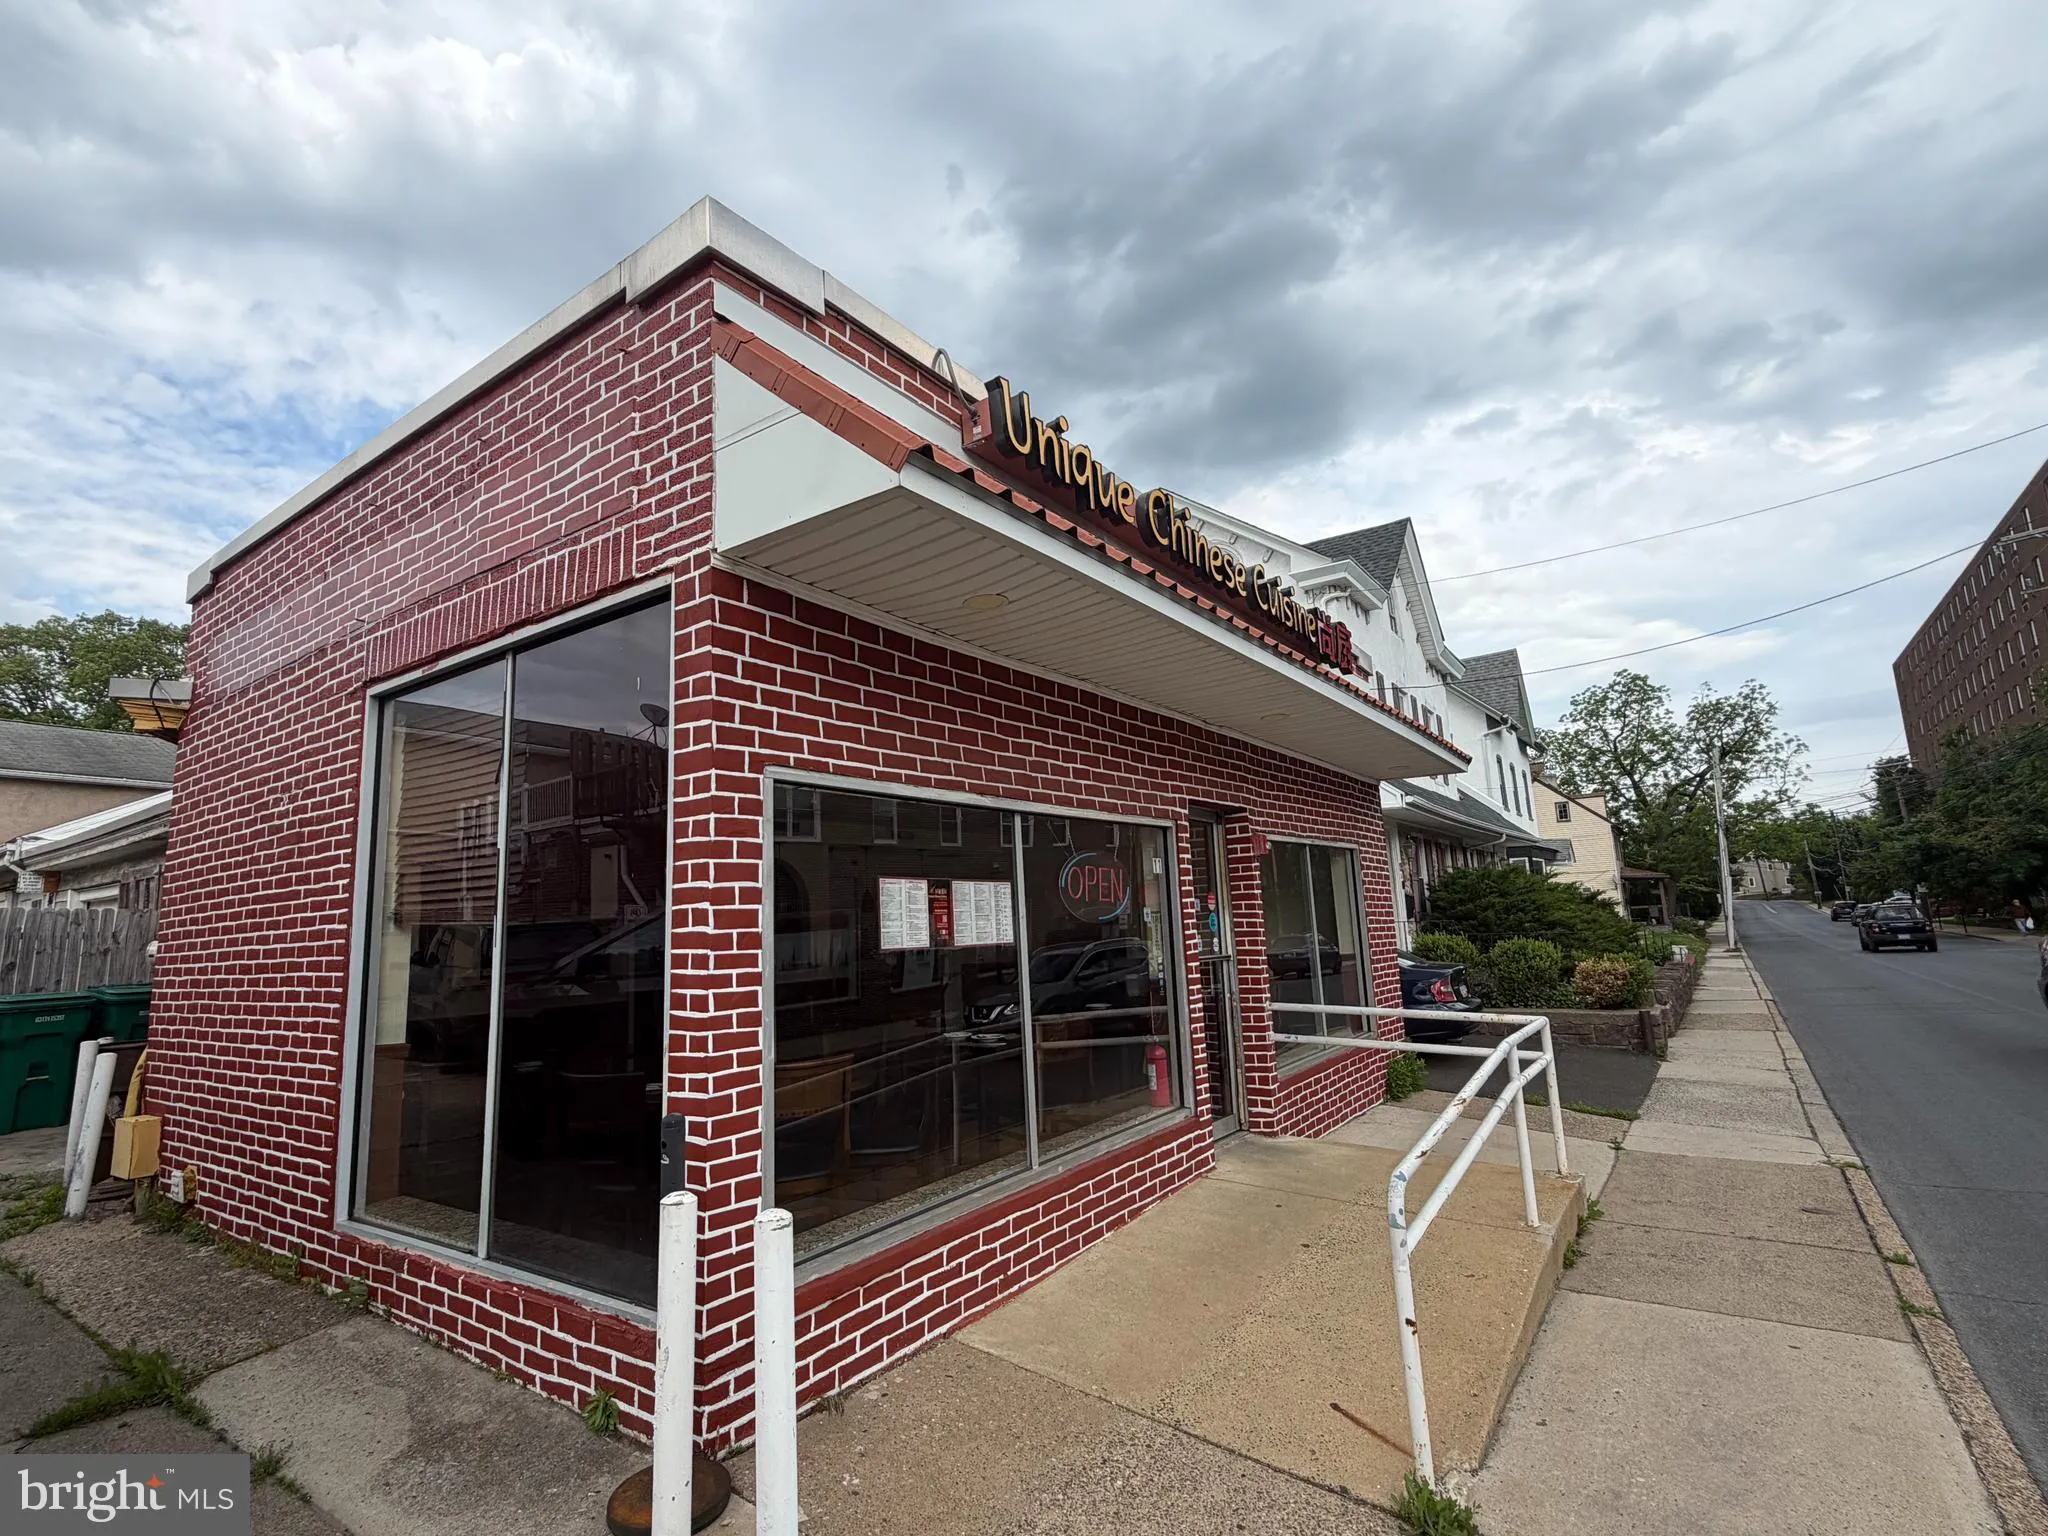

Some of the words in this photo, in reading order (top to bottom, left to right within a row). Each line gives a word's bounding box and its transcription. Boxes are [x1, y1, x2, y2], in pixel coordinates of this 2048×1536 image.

[988, 376, 1137, 527] Unique
[1145, 488, 1248, 597] Chinese
[1251, 563, 1317, 643] Cuisine
[1068, 865, 1123, 903] OPEN
